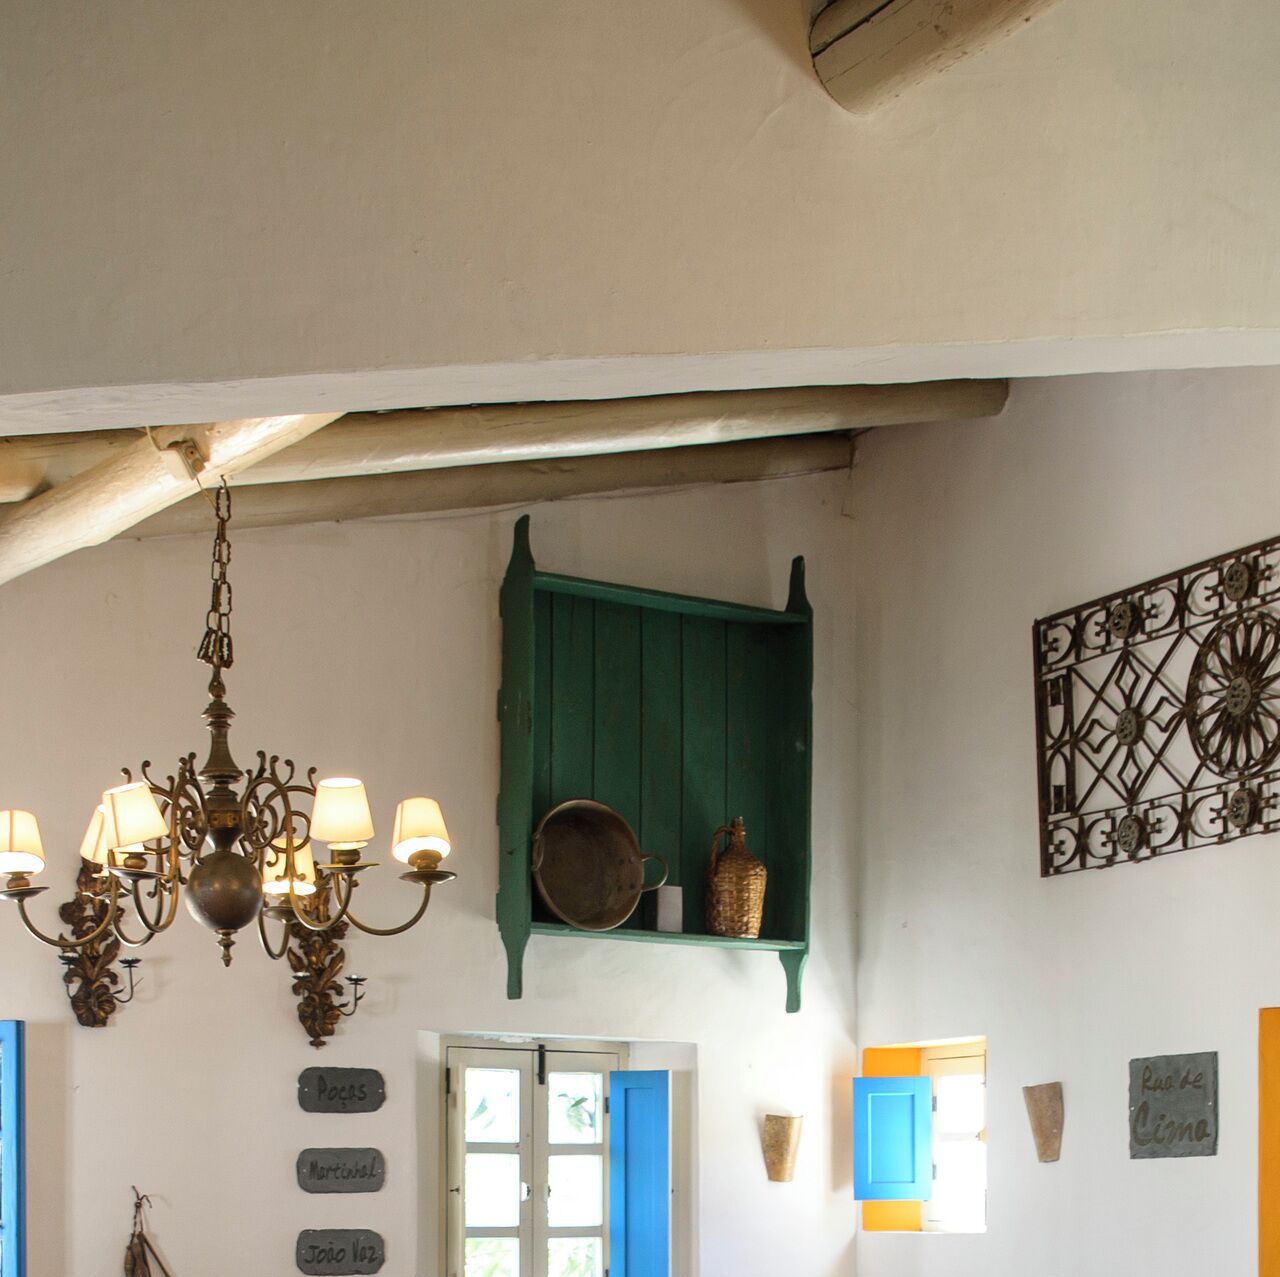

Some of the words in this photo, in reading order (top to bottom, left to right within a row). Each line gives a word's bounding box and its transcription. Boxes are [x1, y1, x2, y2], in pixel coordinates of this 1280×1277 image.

[317, 1075, 367, 1108] Poças
[1141, 1064, 1174, 1095] Rua
[1180, 1068, 1203, 1089] de
[1133, 1100, 1210, 1146] Cima
[309, 1156, 377, 1181] Martinhal
[304, 1241, 346, 1264] João
[352, 1239, 378, 1263] Vaz
